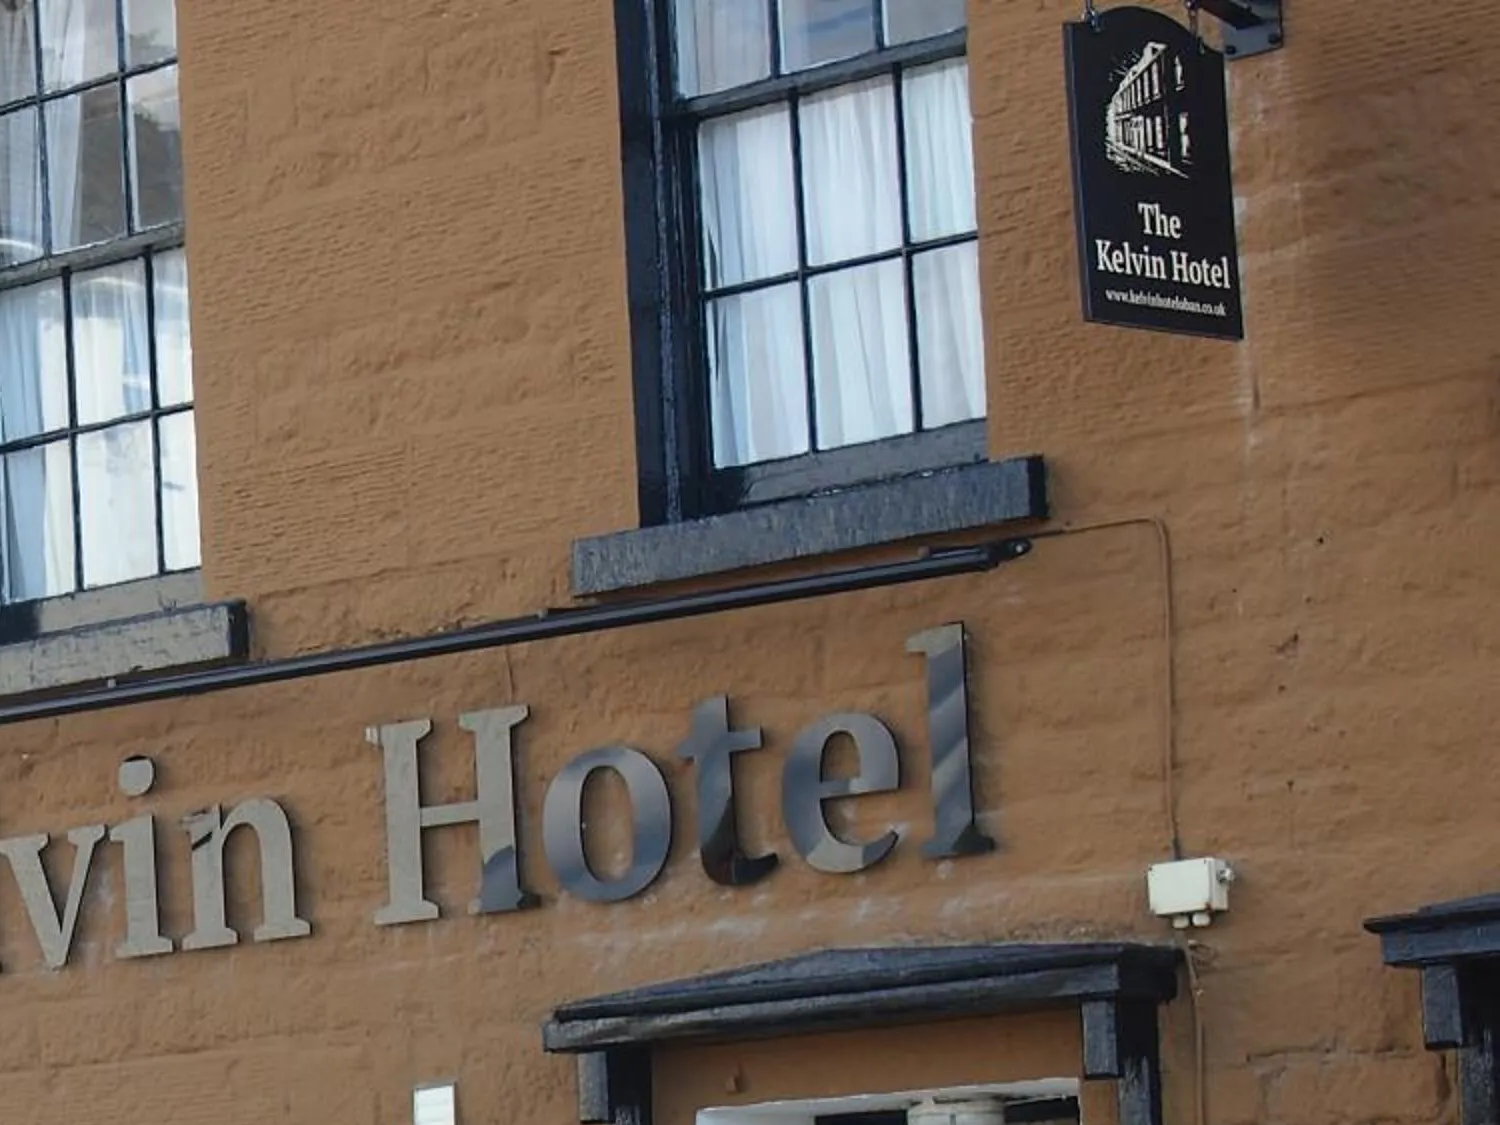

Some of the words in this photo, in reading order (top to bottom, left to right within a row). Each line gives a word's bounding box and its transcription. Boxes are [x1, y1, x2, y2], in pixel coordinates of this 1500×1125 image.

[1137, 202, 1182, 239] The
[1095, 239, 1167, 280] Kelvin
[1171, 251, 1231, 289] Hotel
[366, 620, 998, 926] Hotel
